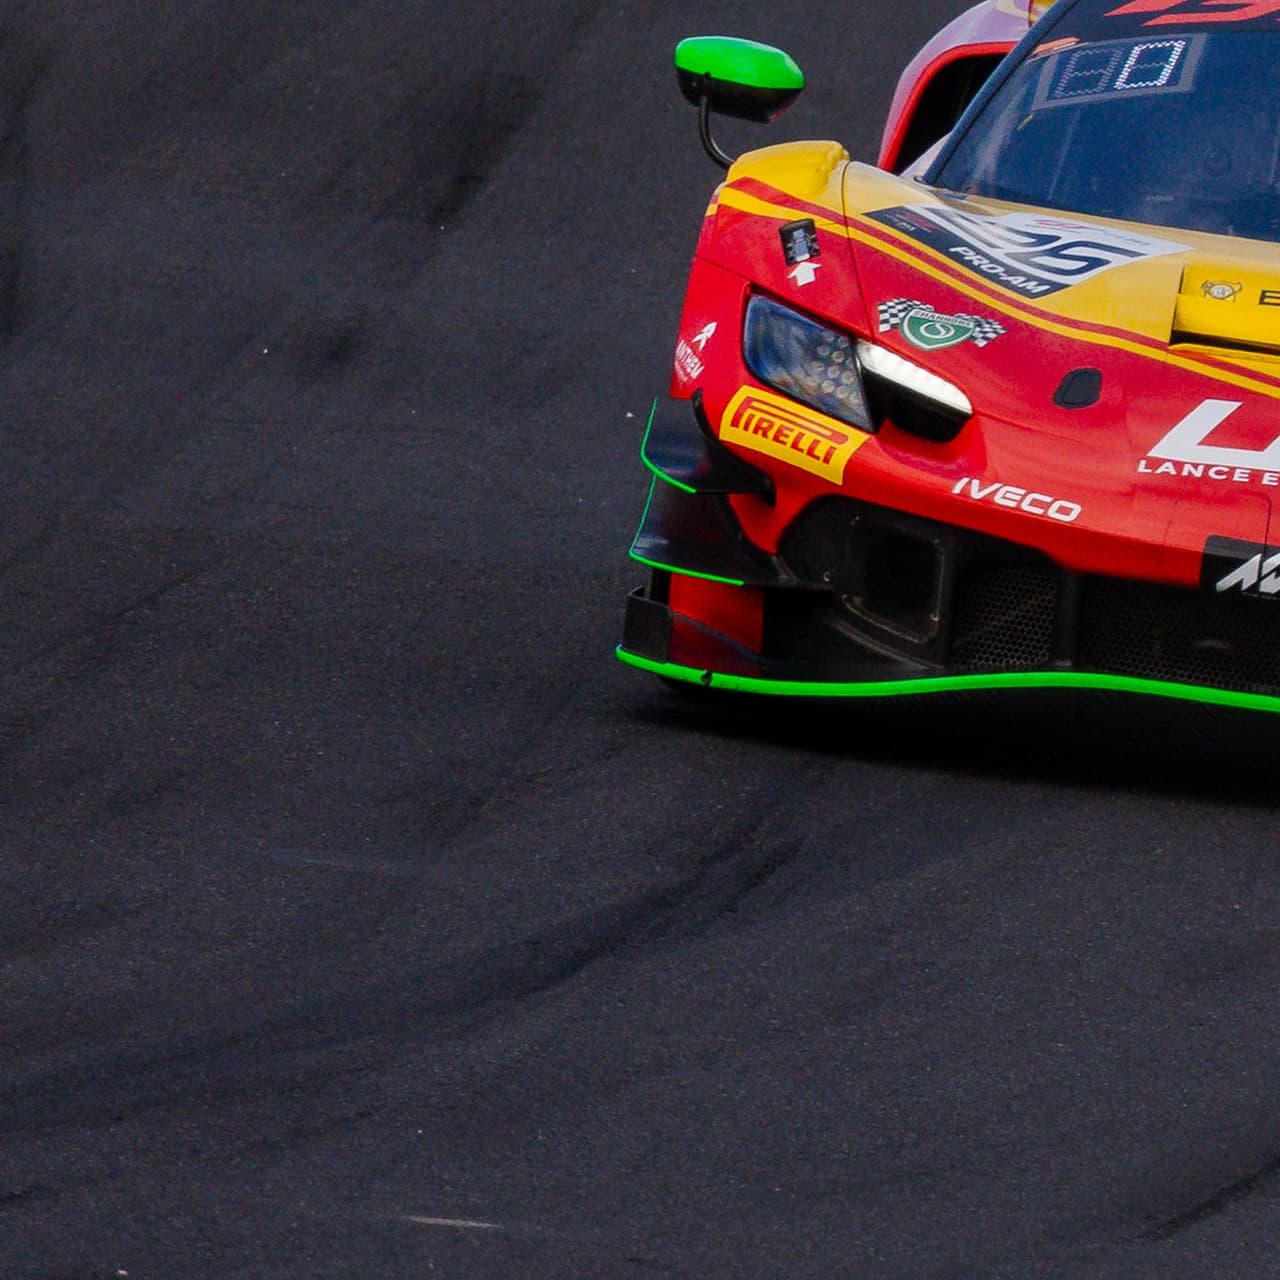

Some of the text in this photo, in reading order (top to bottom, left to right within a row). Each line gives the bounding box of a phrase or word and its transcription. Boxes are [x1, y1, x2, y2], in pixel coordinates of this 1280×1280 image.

[949, 246, 1052, 295] PRO-AM
[729, 395, 850, 466] PIRELLI
[1137, 459, 1250, 483] LANCE
[951, 476, 1083, 523] IVECO
